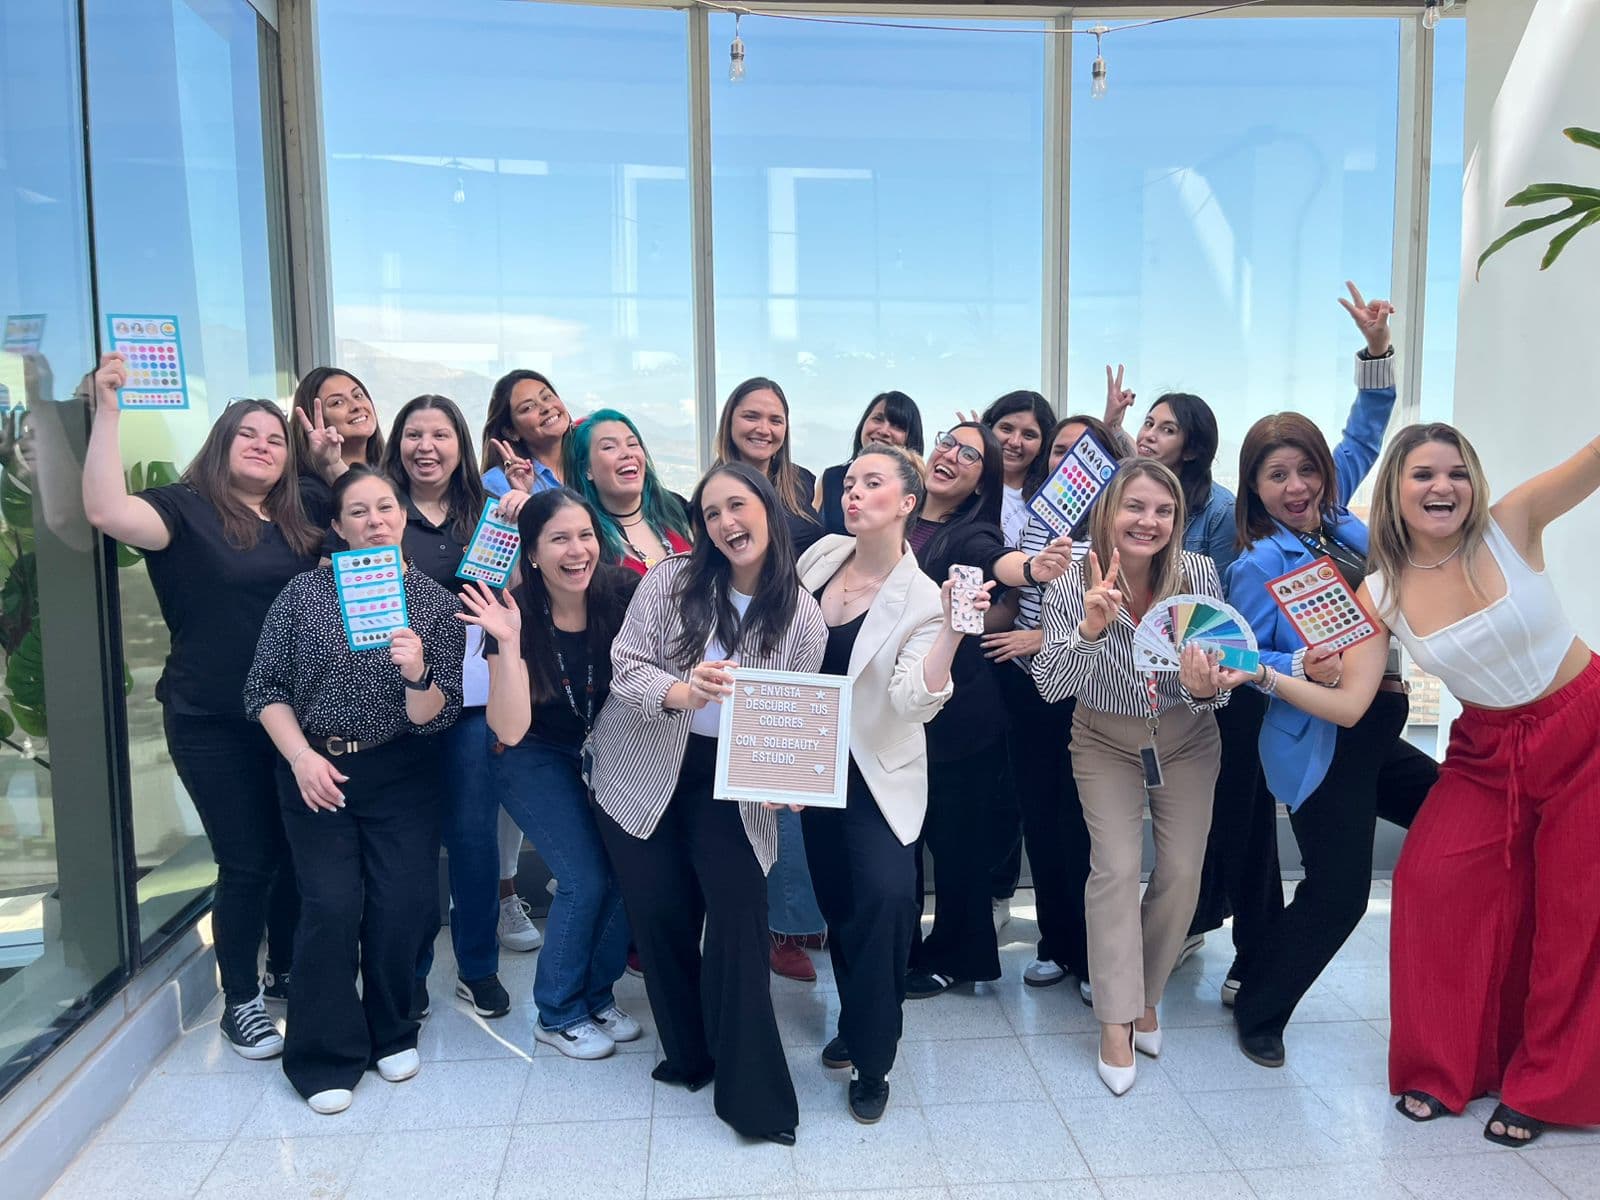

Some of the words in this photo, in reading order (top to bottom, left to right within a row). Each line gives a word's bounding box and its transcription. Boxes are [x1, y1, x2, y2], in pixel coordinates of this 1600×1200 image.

[760, 685, 801, 698] ENVISTA
[745, 699, 797, 713] DESCUBRE
[810, 703, 828, 715] TUS
[759, 715, 803, 728] COLORES
[736, 734, 757, 747] CON
[763, 736, 820, 751] SOLBEAUTY
[752, 751, 795, 764] ESTUDIO
